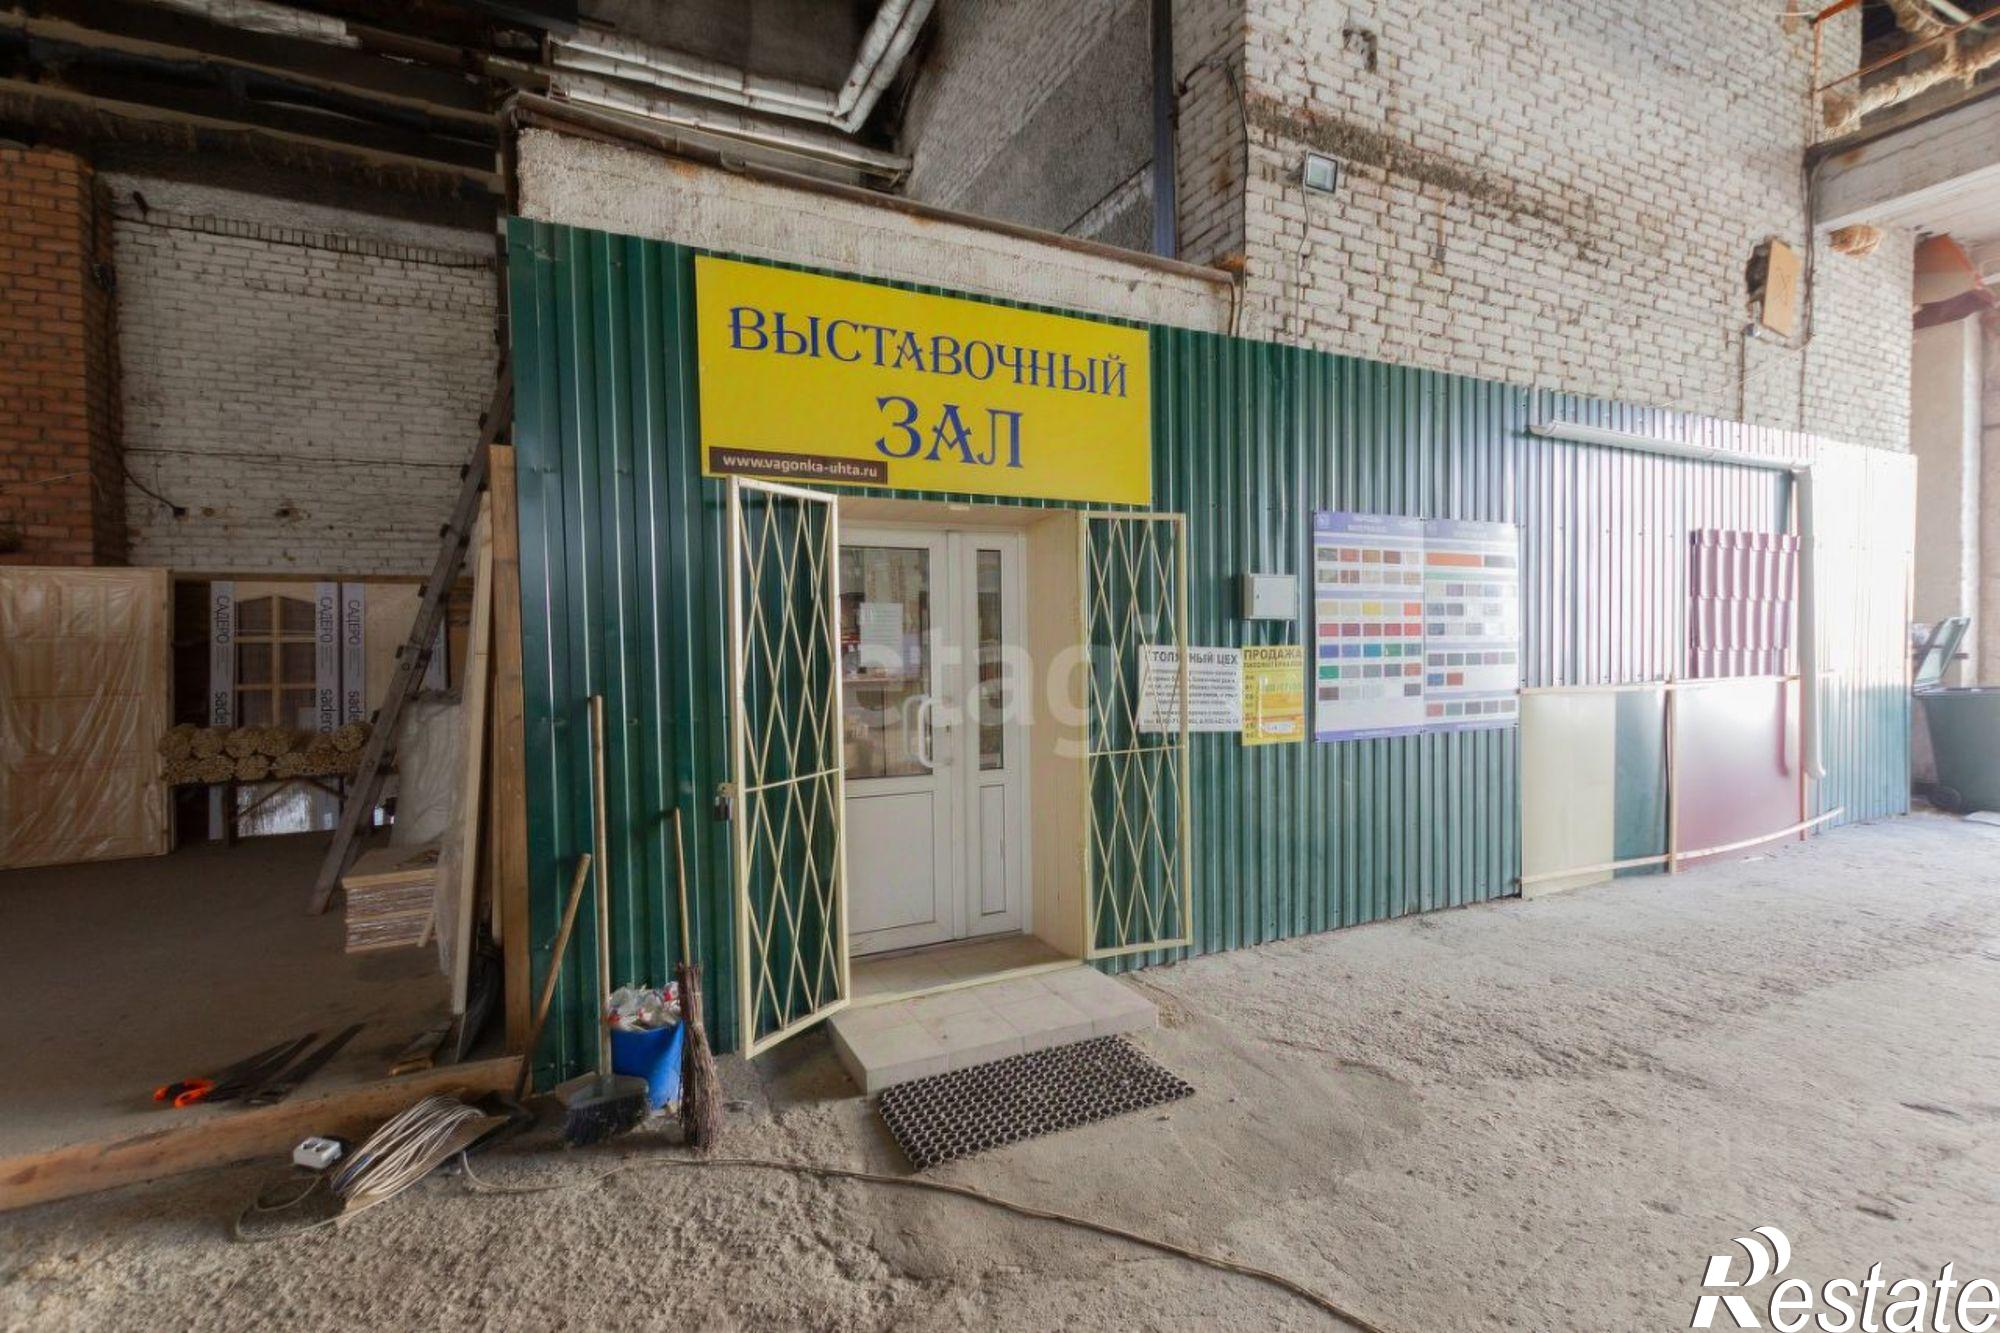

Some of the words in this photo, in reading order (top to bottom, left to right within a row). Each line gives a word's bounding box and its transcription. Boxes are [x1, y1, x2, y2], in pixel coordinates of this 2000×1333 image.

[728, 306, 1127, 398] ВЫСТАВОЧНЫЙ
[875, 396, 1024, 469] ЗАЛ
[722, 453, 878, 478] www.vagonka-uhta.ru
[215, 595, 231, 644] САДЕРО
[320, 688, 336, 734] sadero
